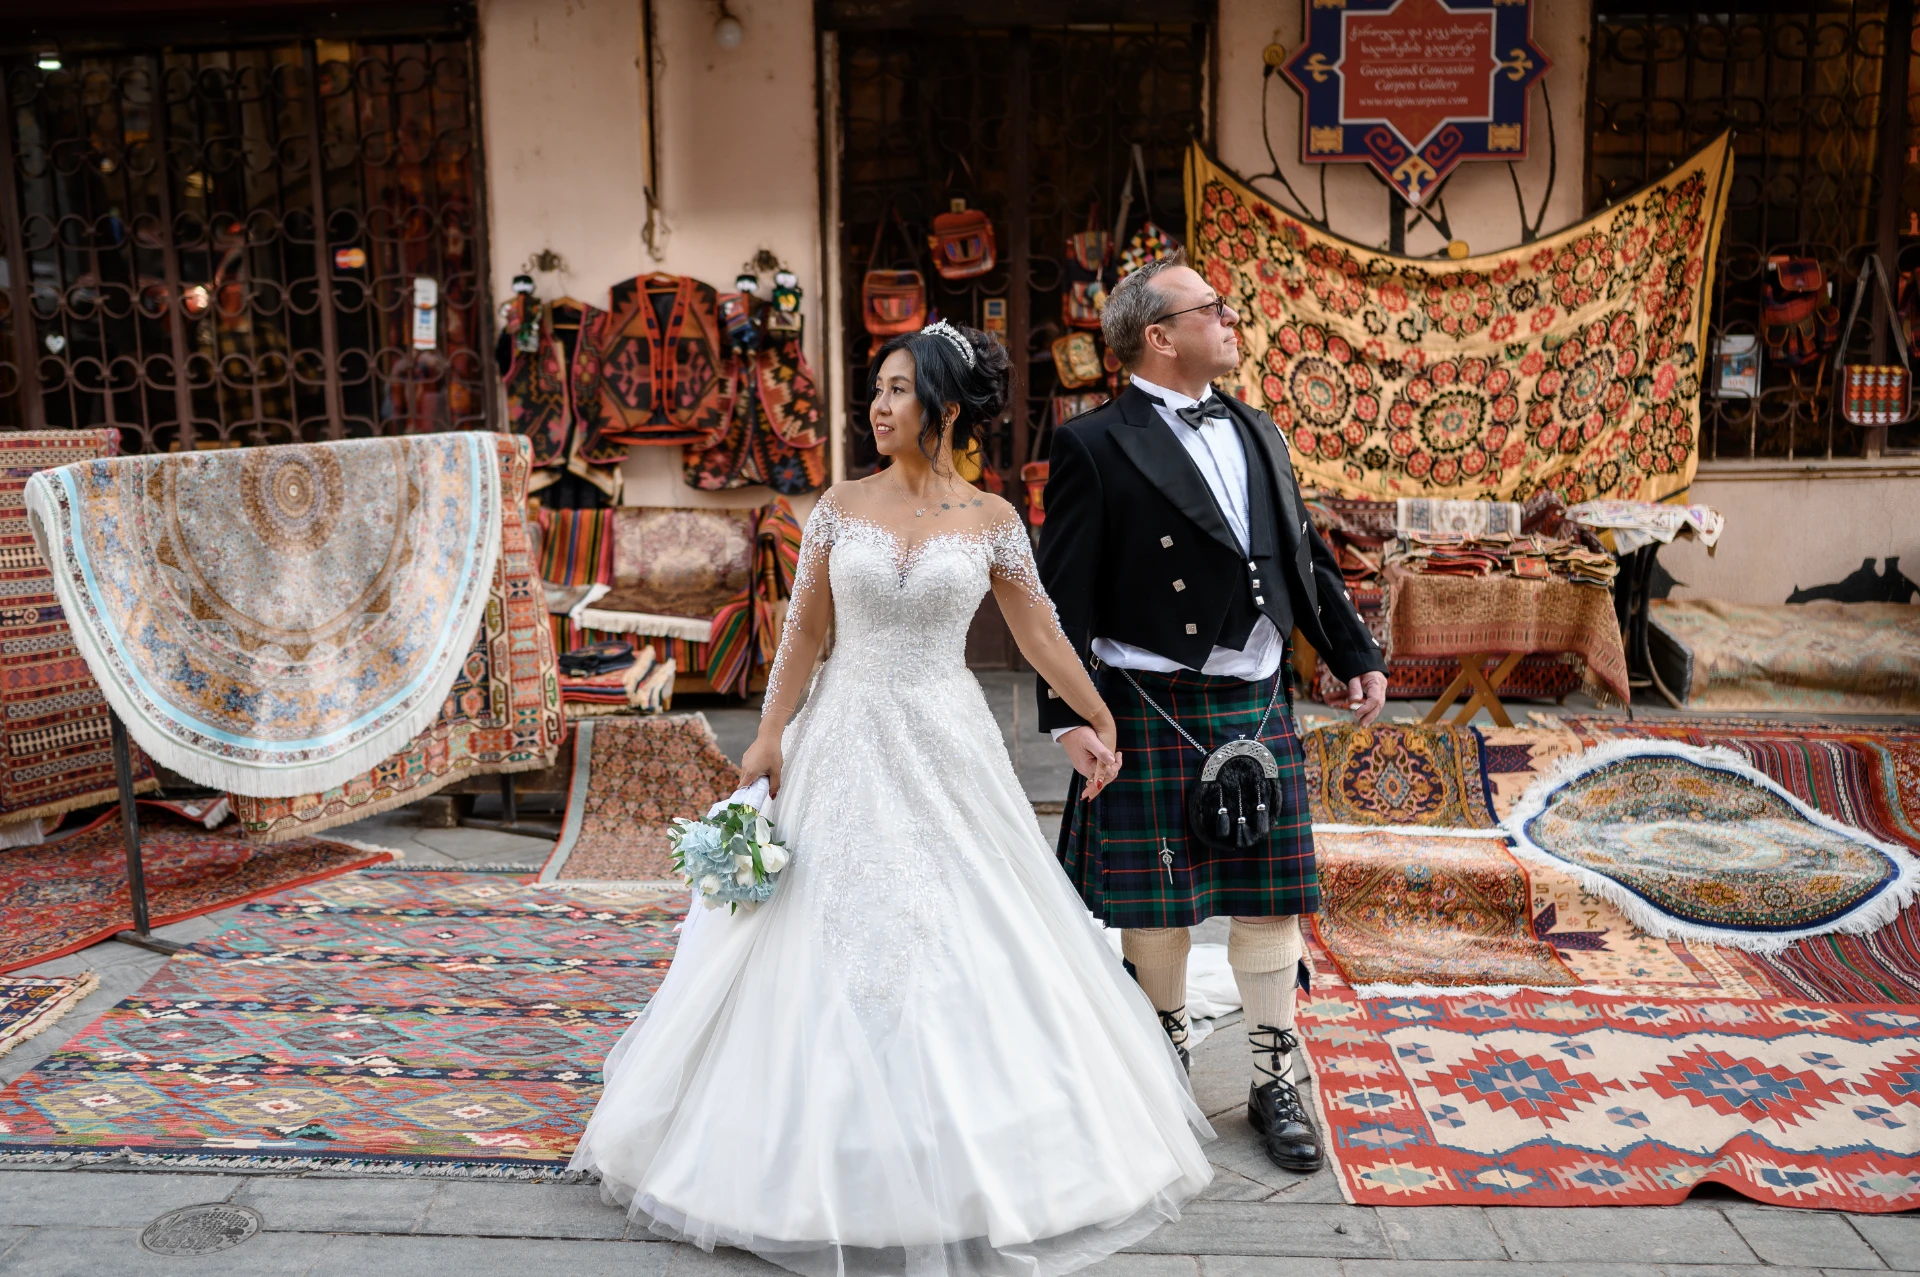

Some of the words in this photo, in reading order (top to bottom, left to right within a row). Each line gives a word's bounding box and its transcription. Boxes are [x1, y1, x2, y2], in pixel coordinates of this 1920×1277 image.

[1408, 28, 1422, 40] და
[1375, 80, 1416, 92] Carpets
[1419, 79, 1459, 92] Gallery
